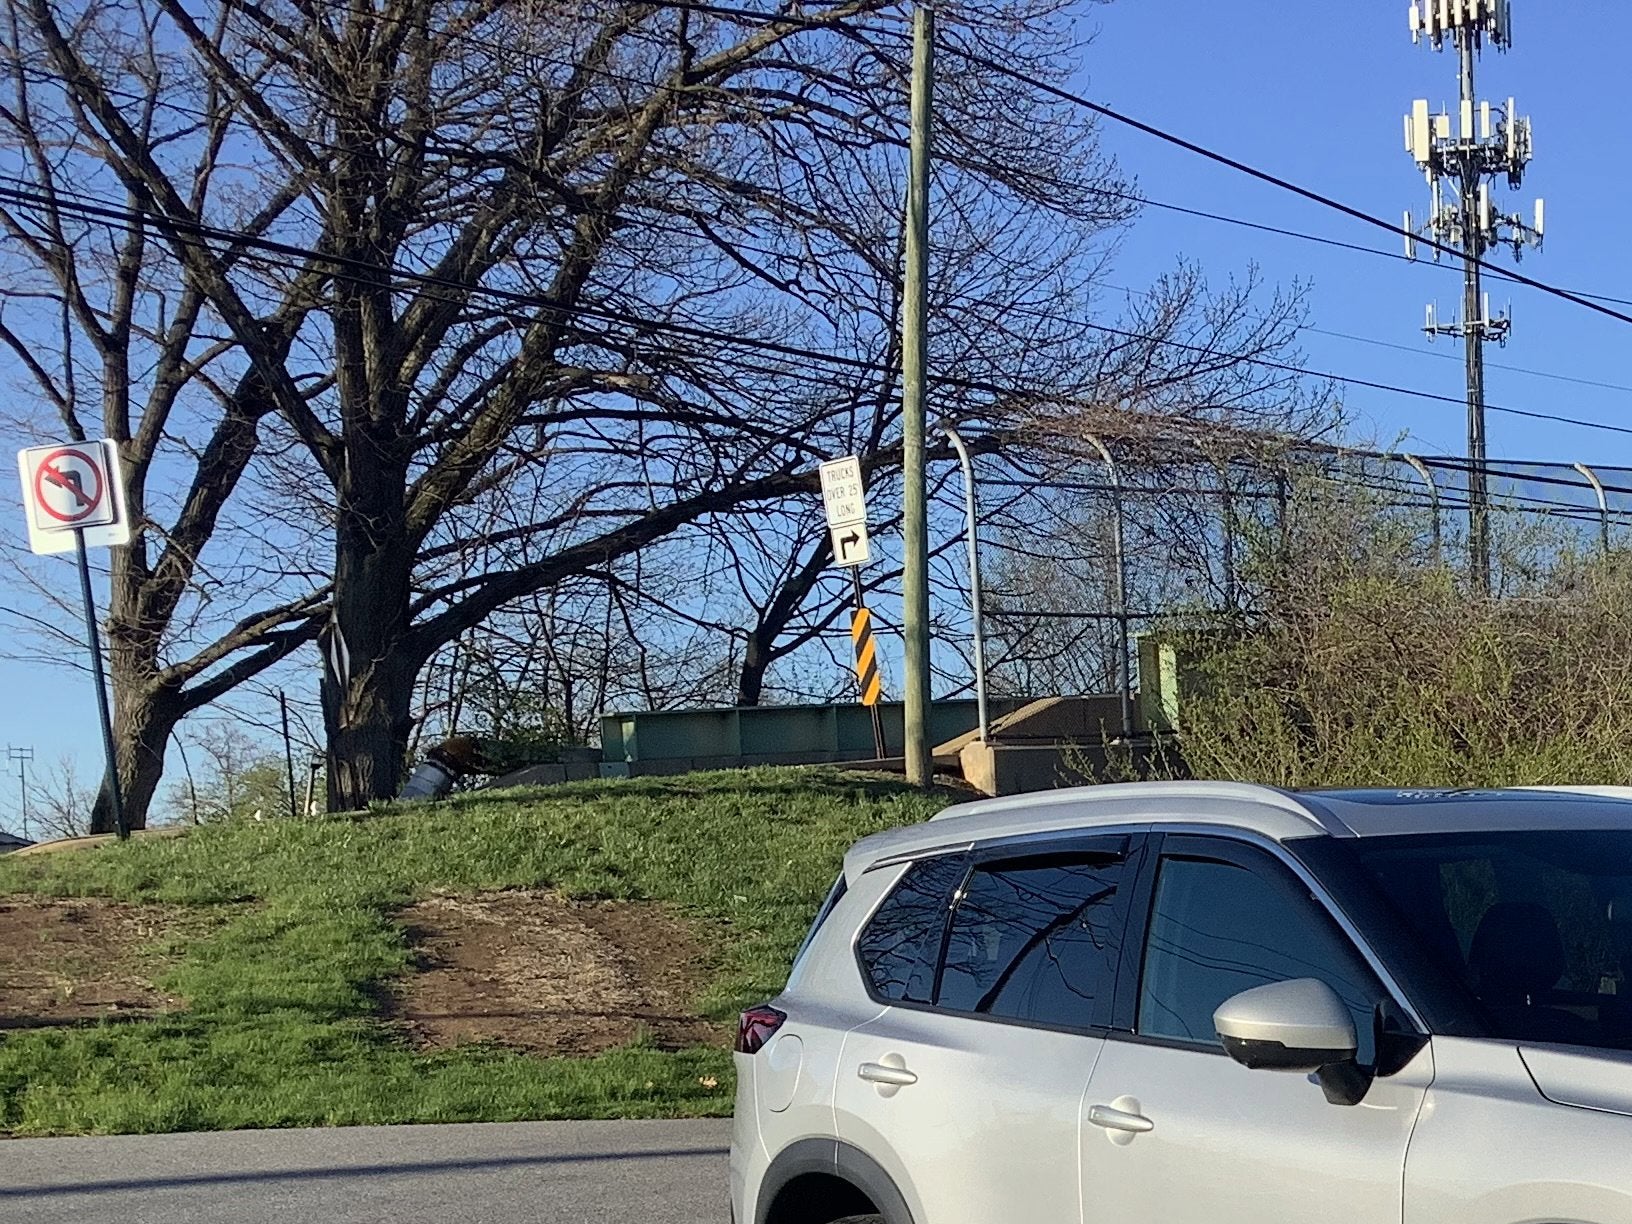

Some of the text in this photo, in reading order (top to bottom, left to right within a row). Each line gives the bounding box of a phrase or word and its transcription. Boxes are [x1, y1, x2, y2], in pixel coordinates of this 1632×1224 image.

[826, 466, 854, 482] TRUCKS
[826, 486, 846, 501] OVER
[836, 503, 856, 517] LONG
